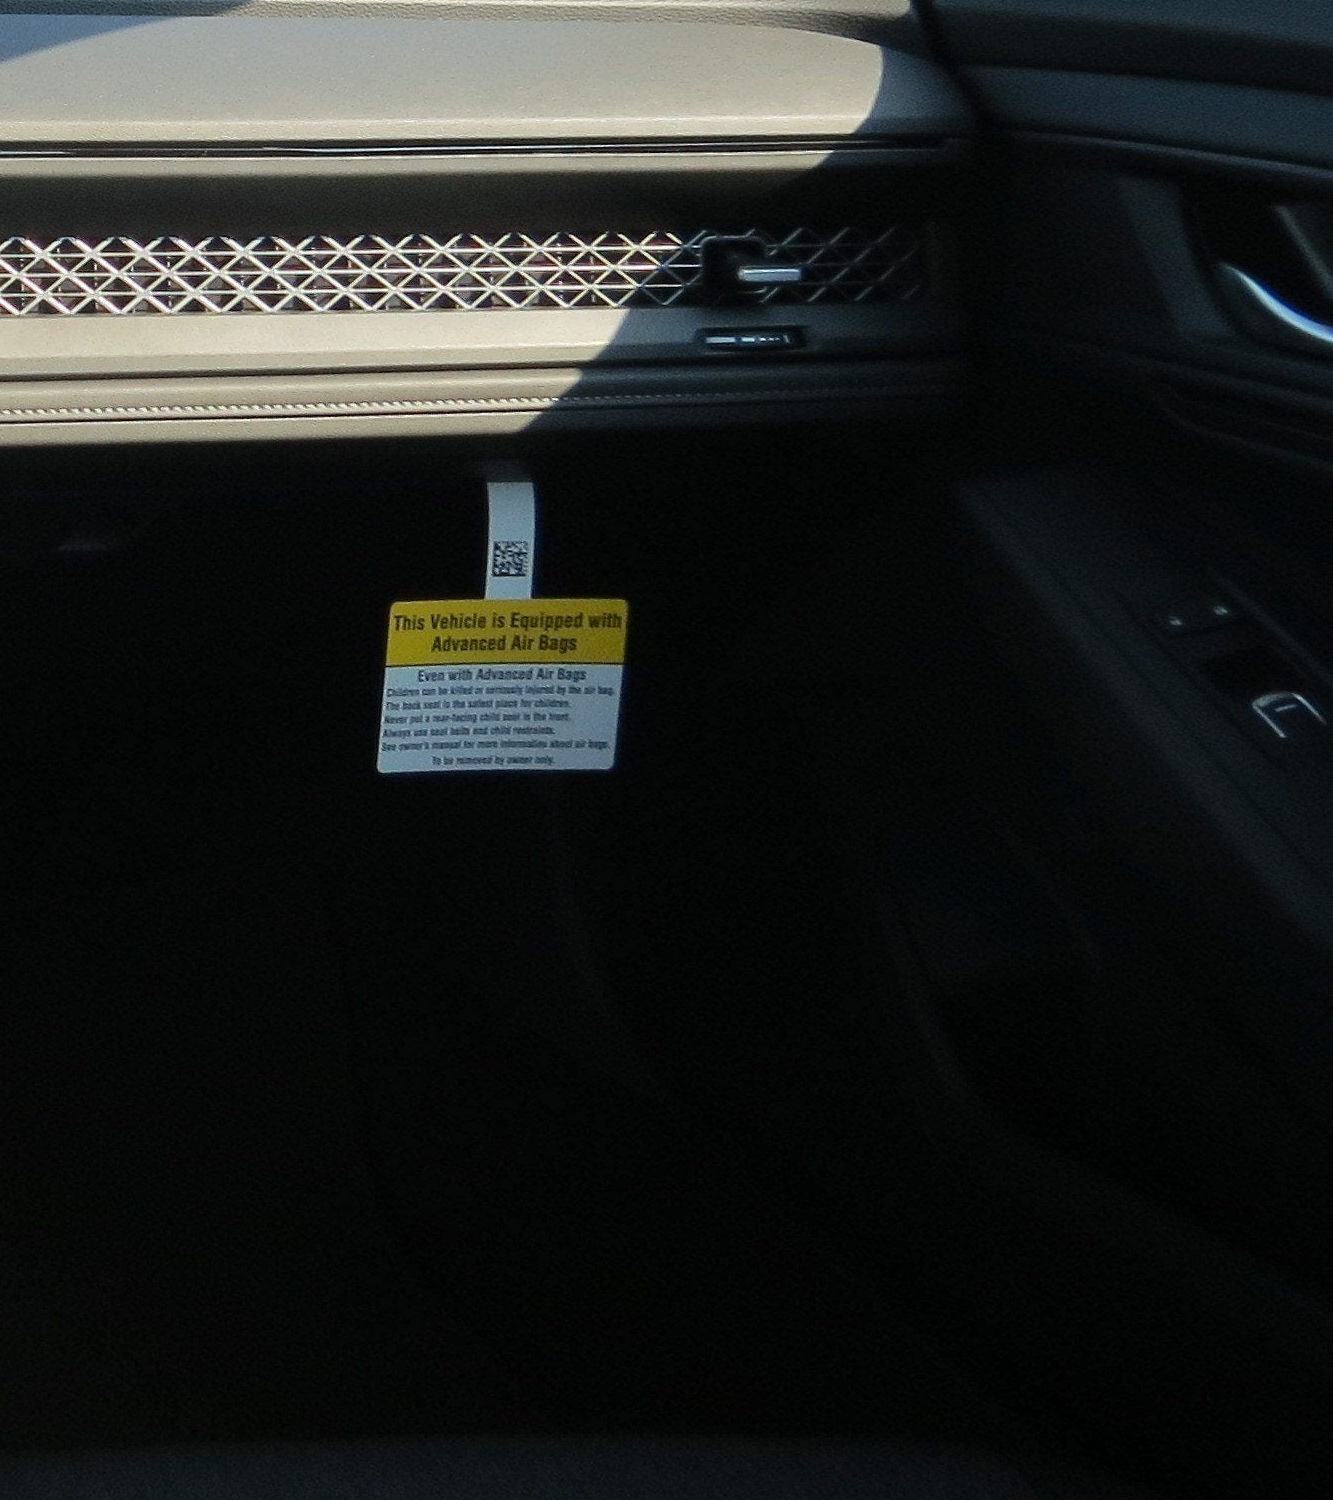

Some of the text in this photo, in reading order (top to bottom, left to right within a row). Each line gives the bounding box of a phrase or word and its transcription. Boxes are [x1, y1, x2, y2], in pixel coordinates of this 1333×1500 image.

[394, 612, 623, 632] This Vehicle is Equipped with
[431, 635, 577, 654] Advanced Air Bags
[417, 668, 587, 683] Even with Advanced Air Bags
